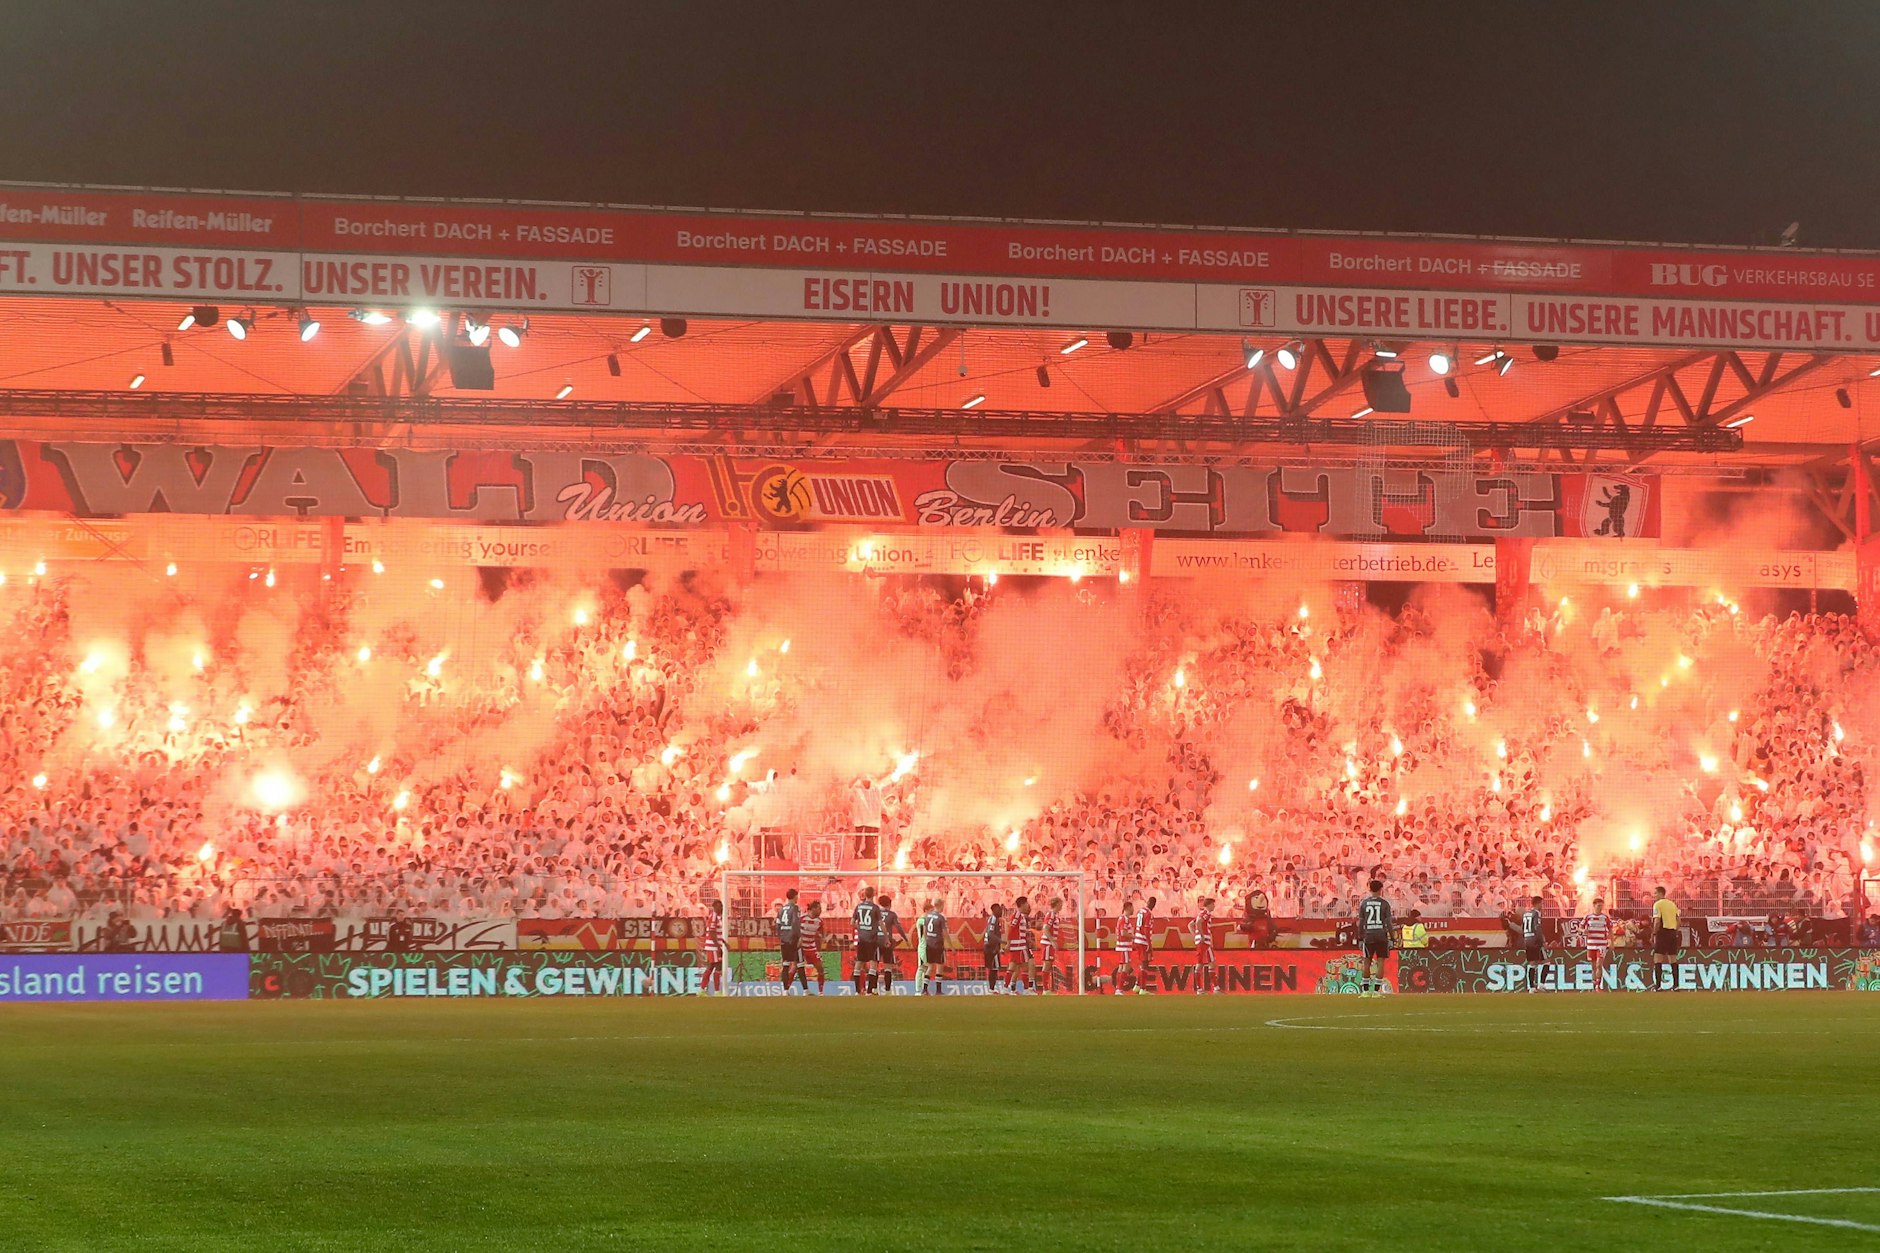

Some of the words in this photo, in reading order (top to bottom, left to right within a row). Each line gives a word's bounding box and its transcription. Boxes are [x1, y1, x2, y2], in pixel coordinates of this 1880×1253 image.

[132, 208, 273, 232] Reifen-Müller
[334, 217, 426, 237] Borchert
[433, 222, 492, 240] DACH
[499, 229, 510, 241] +
[516, 225, 614, 244] FASSADE
[677, 230, 766, 250] Borchert
[773, 235, 829, 253] DACH
[836, 241, 848, 253] +
[853, 237, 947, 256] FASSADE
[1008, 242, 1094, 262] Borchert
[1101, 247, 1155, 264] DACH
[1162, 253, 1173, 265] +
[1178, 249, 1270, 268] FASSADE
[53, 251, 163, 288] UNSER
[173, 255, 284, 292] STOLZ.
[1329, 252, 1412, 271] Borchert
[1419, 257, 1472, 274] DACH
[1493, 260, 1582, 278] FASSADE
[1650, 263, 1728, 287] BUG
[1733, 269, 1852, 287] VERKEHRSBAU
[1857, 273, 1875, 288] SE
[303, 260, 410, 296] UNSER
[420, 263, 548, 301] VEREIN.
[803, 277, 914, 313] EISERN
[941, 281, 1050, 317] UNION!
[1296, 293, 1409, 327] UNSERE
[1418, 297, 1508, 331] LIEBE.
[1527, 301, 1639, 336] UNSERE
[1652, 306, 1853, 342] MANNSCHAFT.
[556, 482, 707, 521] Union
[811, 477, 901, 517] UNION
[914, 490, 1057, 527] Berlin
[1472, 552, 1496, 568] Le
[857, 909, 872, 926] 16
[927, 918, 934, 932] 6
[1365, 905, 1383, 925] 21
[0, 965, 86, 995] sland
[97, 965, 203, 994] reisen
[348, 967, 496, 995] SPIELEN
[504, 967, 529, 995] &
[535, 967, 732, 995] GEWINNE
[1624, 963, 1648, 991] &
[1652, 963, 1828, 990] GEWINNEN
